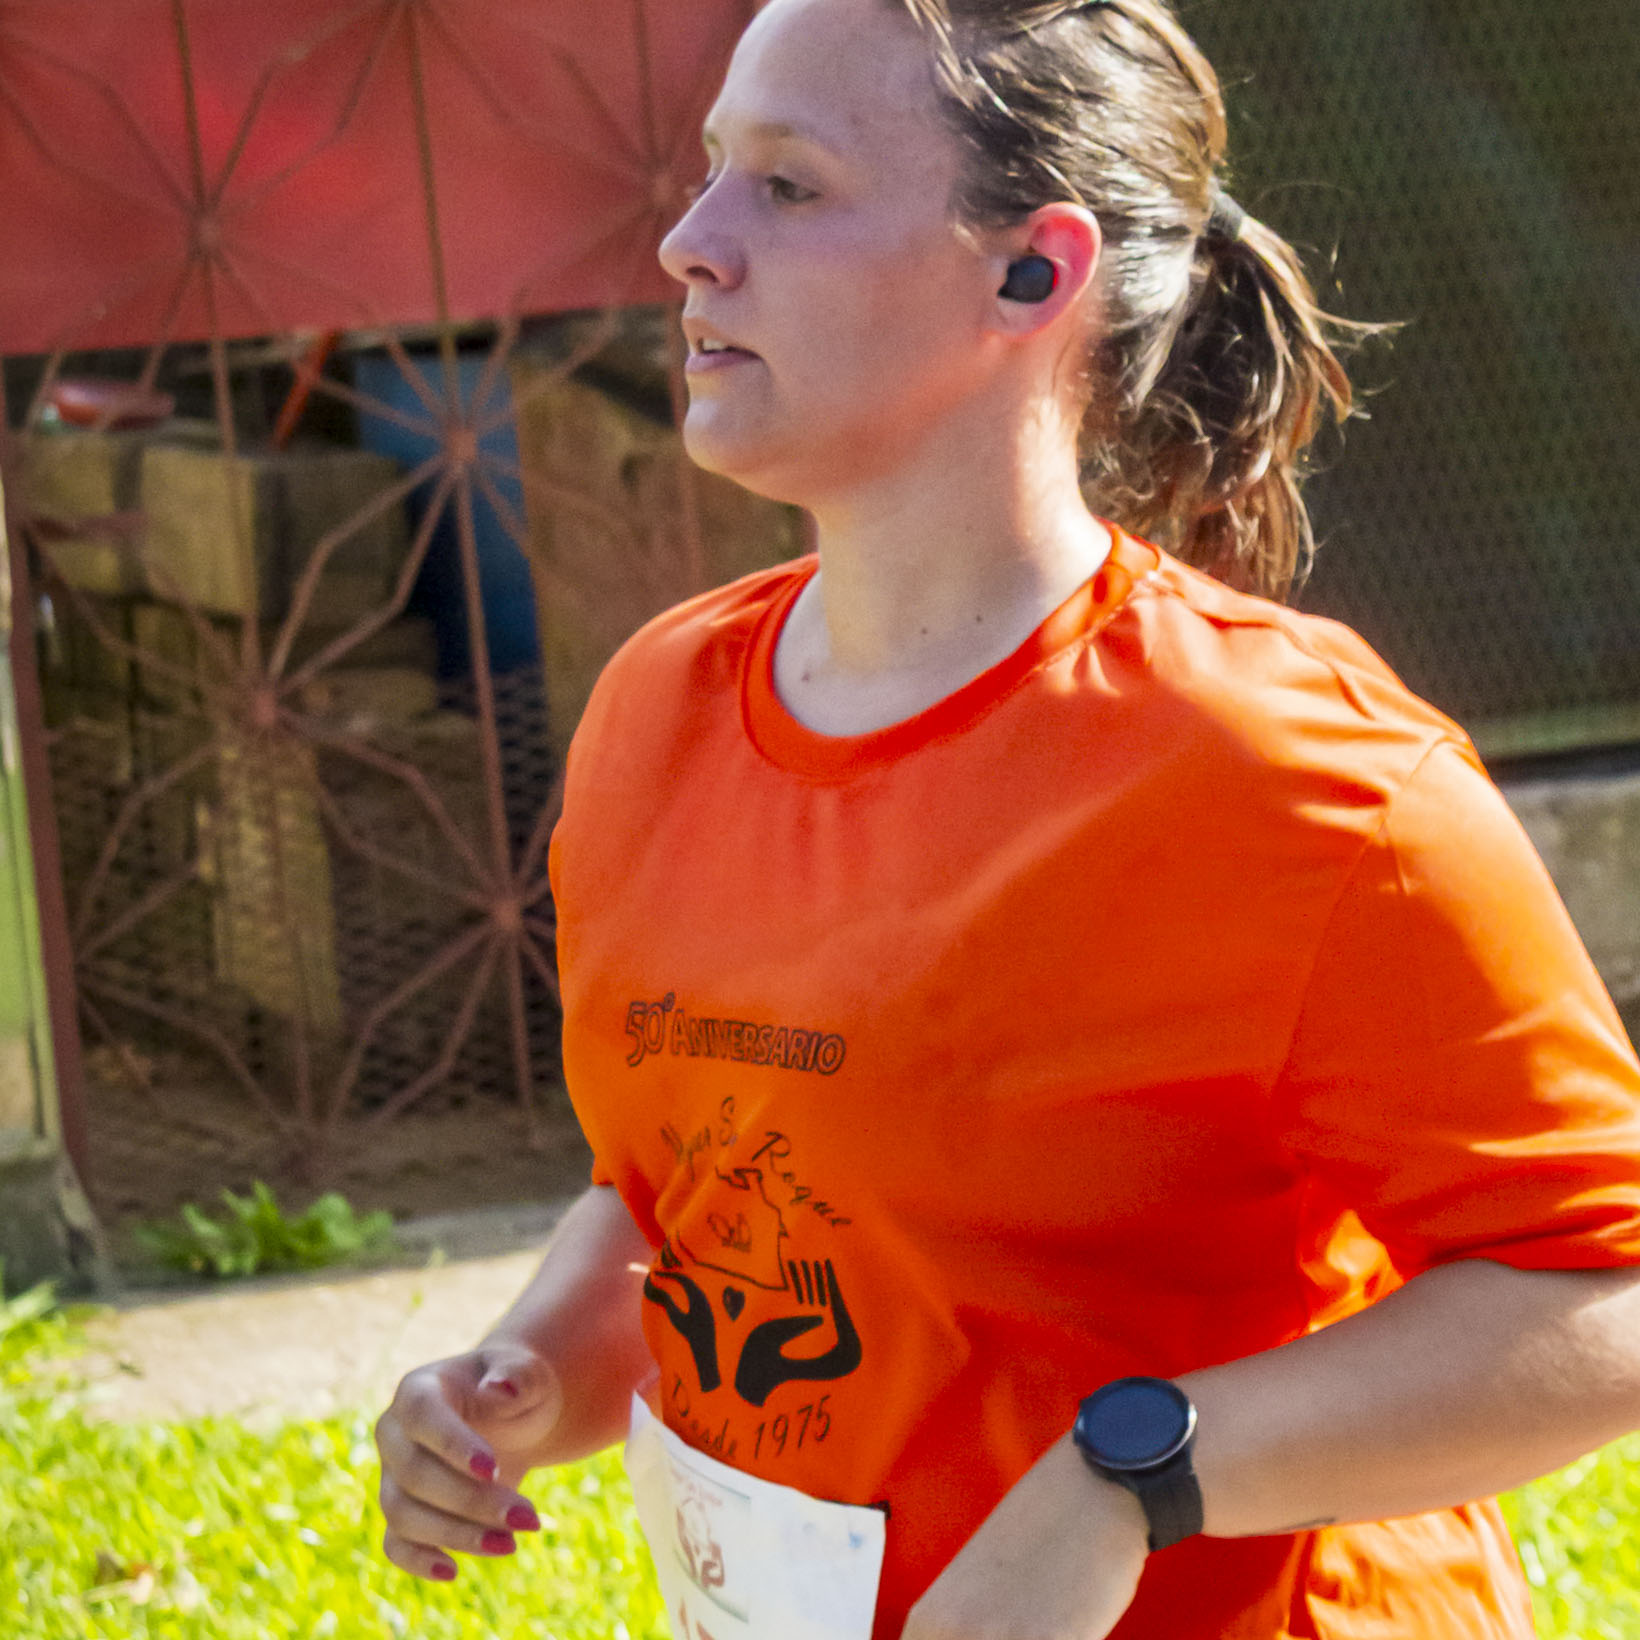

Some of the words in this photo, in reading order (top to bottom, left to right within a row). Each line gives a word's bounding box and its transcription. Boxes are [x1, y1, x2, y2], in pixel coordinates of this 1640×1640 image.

[671, 1007, 846, 1076] ANIVERSARIO
[751, 1130, 851, 1227] Roque
[754, 1394, 831, 1459] 1975
